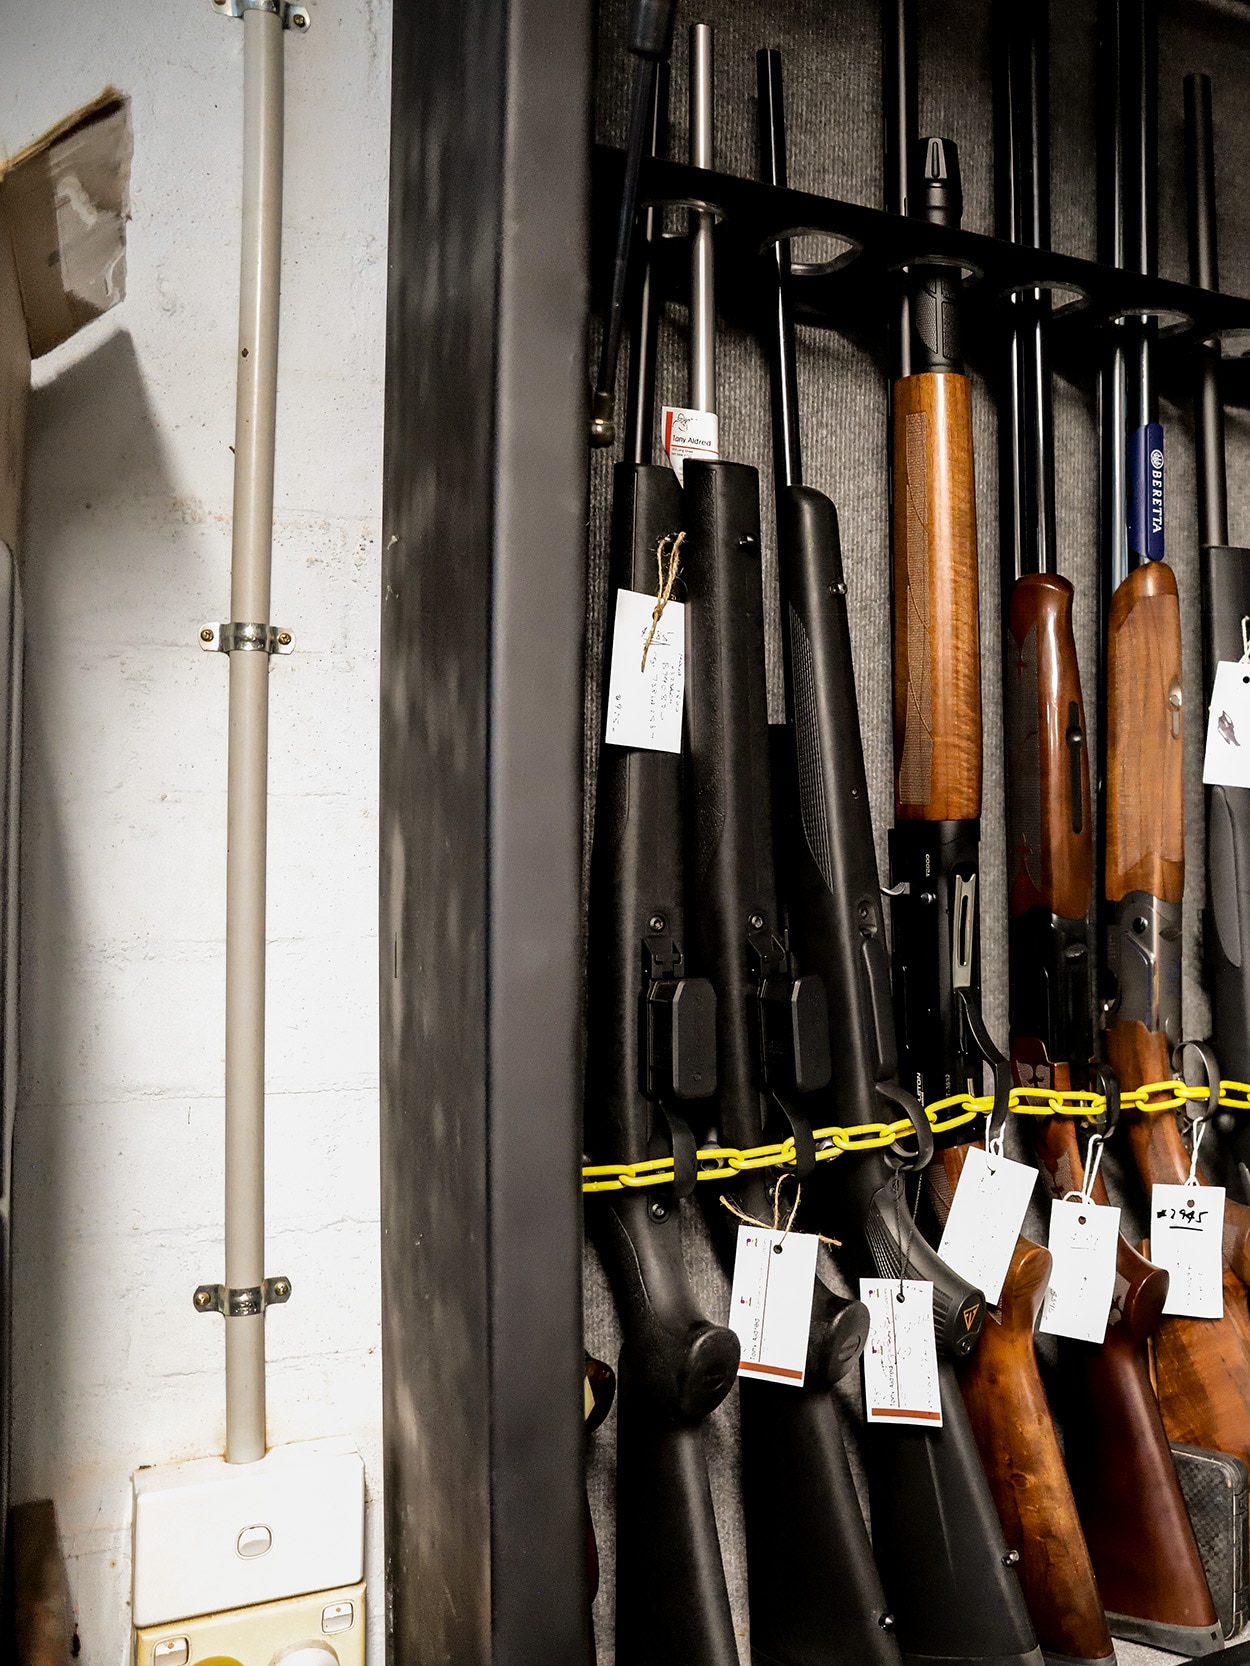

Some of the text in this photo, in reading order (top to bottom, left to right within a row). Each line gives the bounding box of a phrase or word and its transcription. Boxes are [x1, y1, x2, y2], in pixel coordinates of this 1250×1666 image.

[672, 434, 712, 447] Tony Aldred
[1152, 471, 1162, 533] BERETTA
